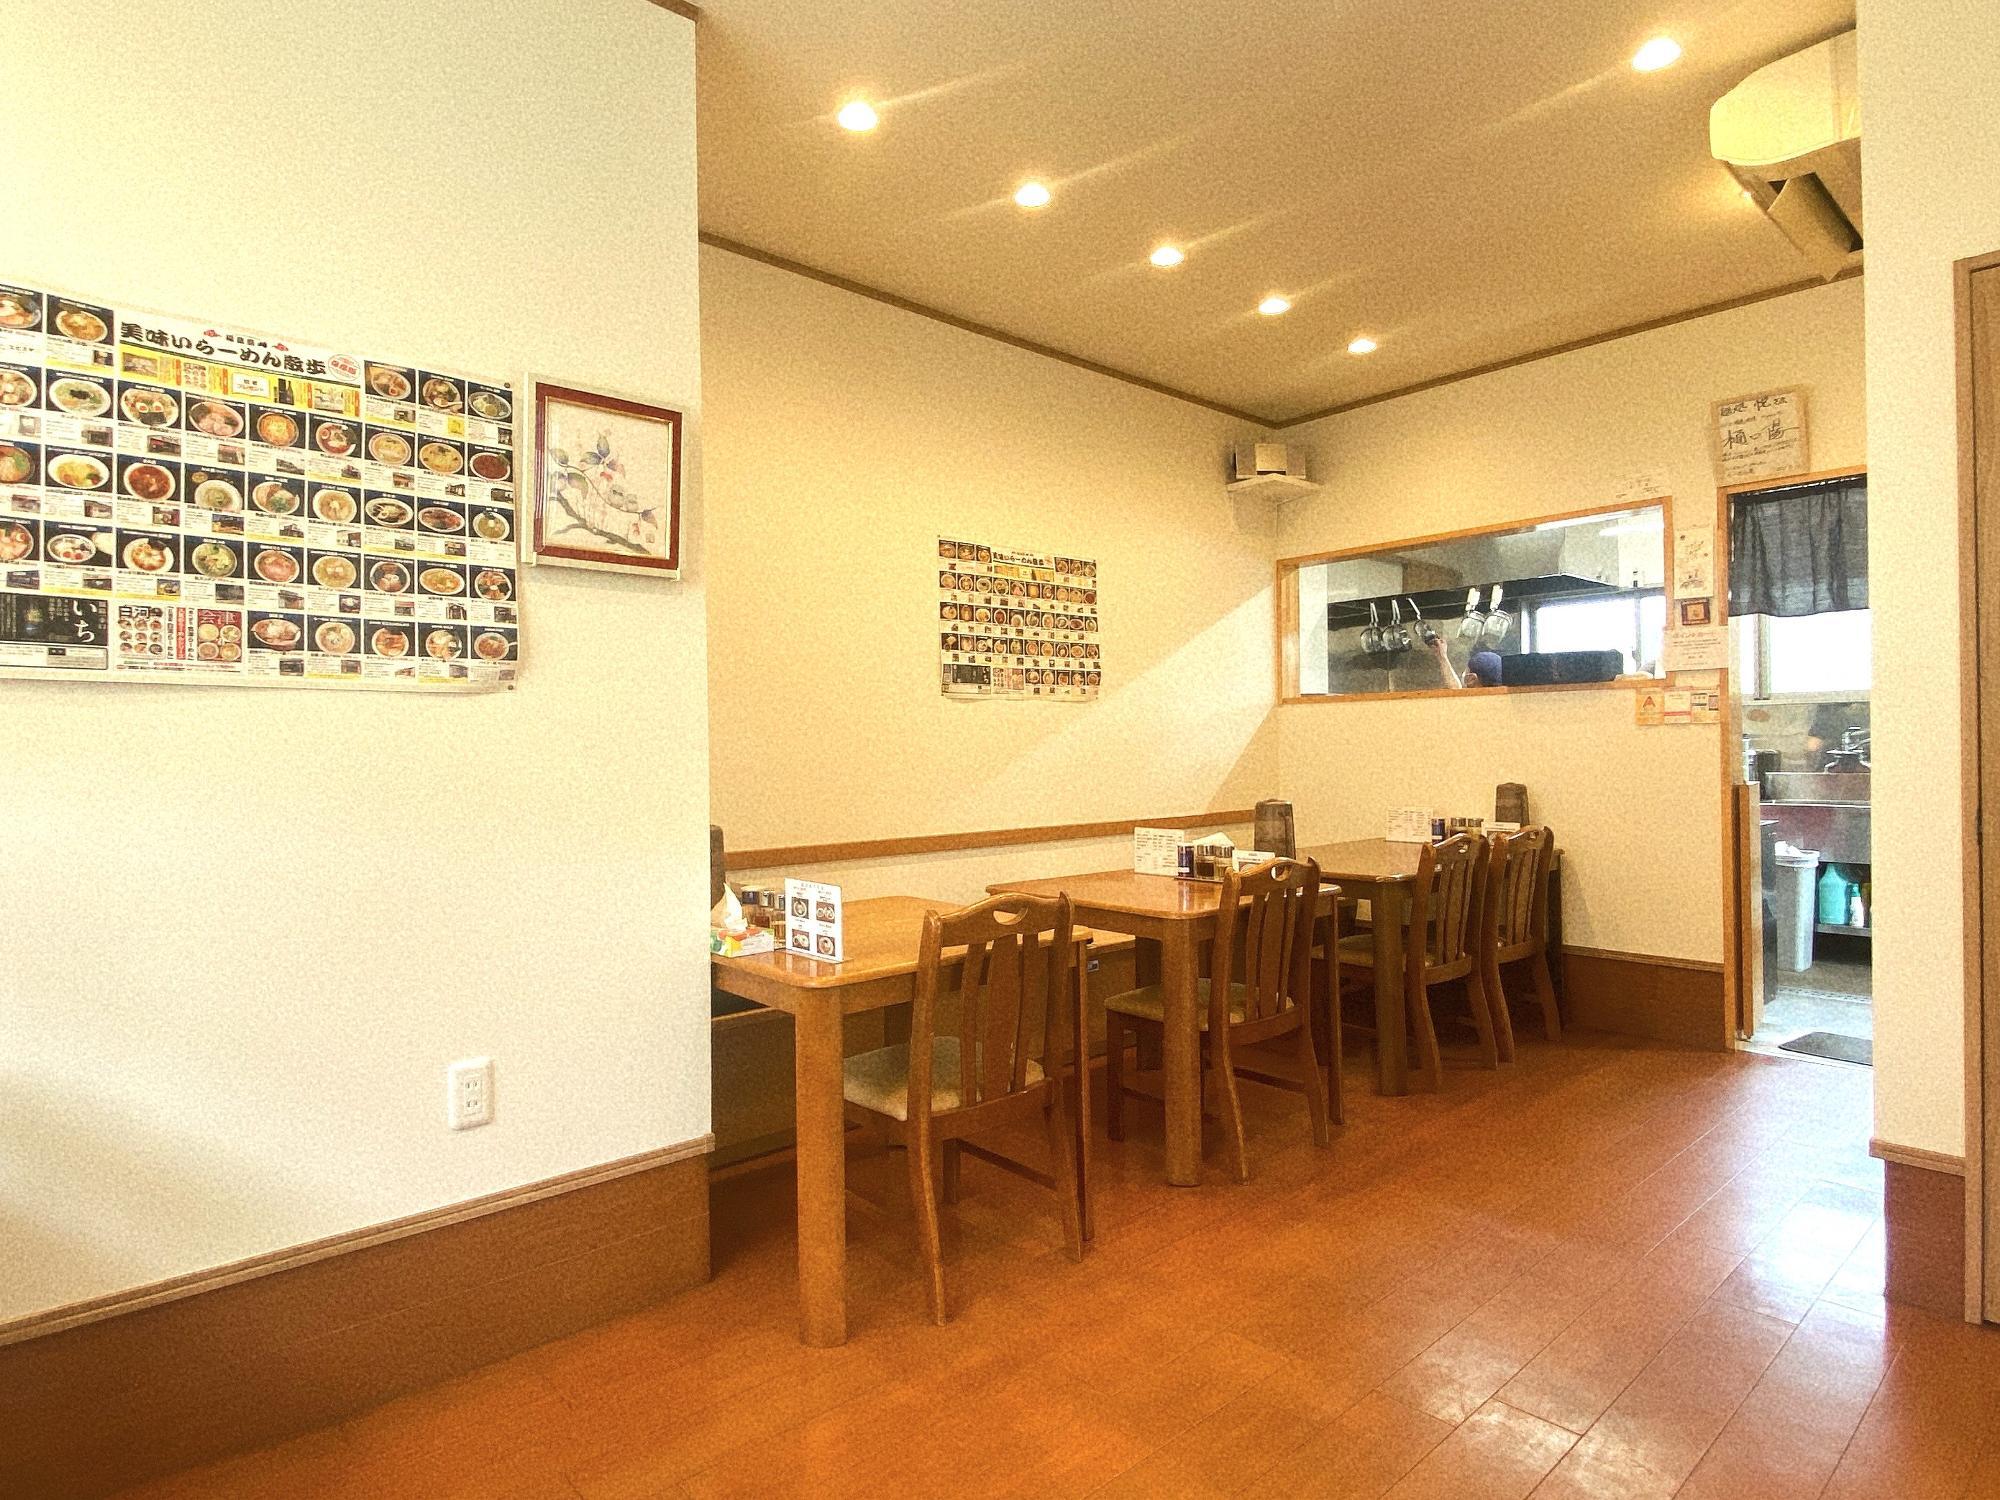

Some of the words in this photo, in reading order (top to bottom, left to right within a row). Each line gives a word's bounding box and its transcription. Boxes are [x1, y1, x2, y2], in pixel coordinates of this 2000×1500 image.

[120, 321, 326, 375] 美味いらーめん散歩
